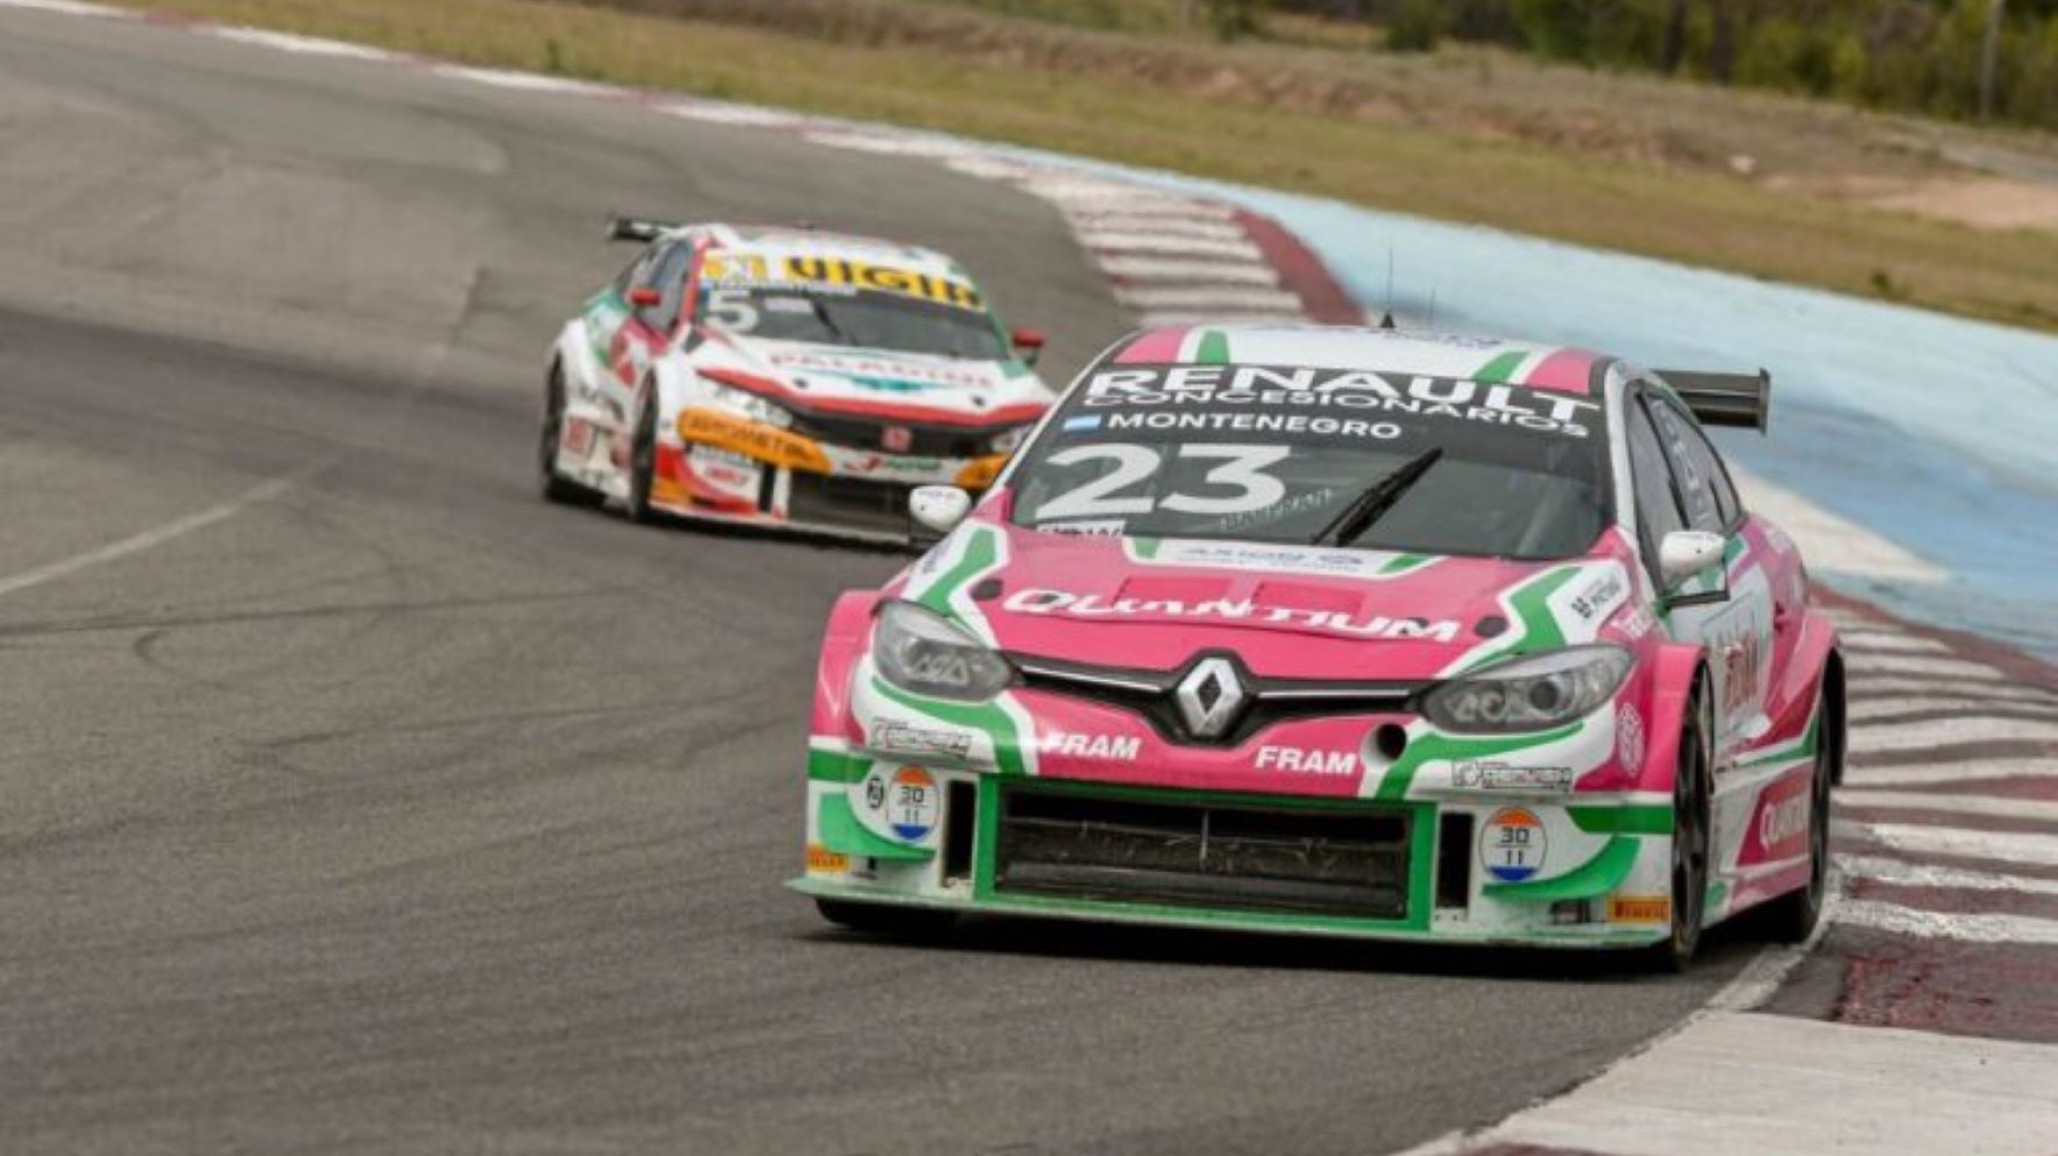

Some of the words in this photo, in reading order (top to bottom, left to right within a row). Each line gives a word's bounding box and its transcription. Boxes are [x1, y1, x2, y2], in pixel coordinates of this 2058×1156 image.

[704, 289, 760, 333] 5
[1087, 366, 1601, 422] RENAULT
[1083, 388, 1590, 437] CONCESIONARIOS
[1108, 412, 1401, 439] MONTENEGRO
[1034, 442, 1293, 520] 23
[1041, 731, 1142, 760] FRAM
[1254, 745, 1357, 776] FRAM
[899, 785, 925, 806] 30
[1500, 825, 1530, 844] 30
[1506, 849, 1524, 866] 11
